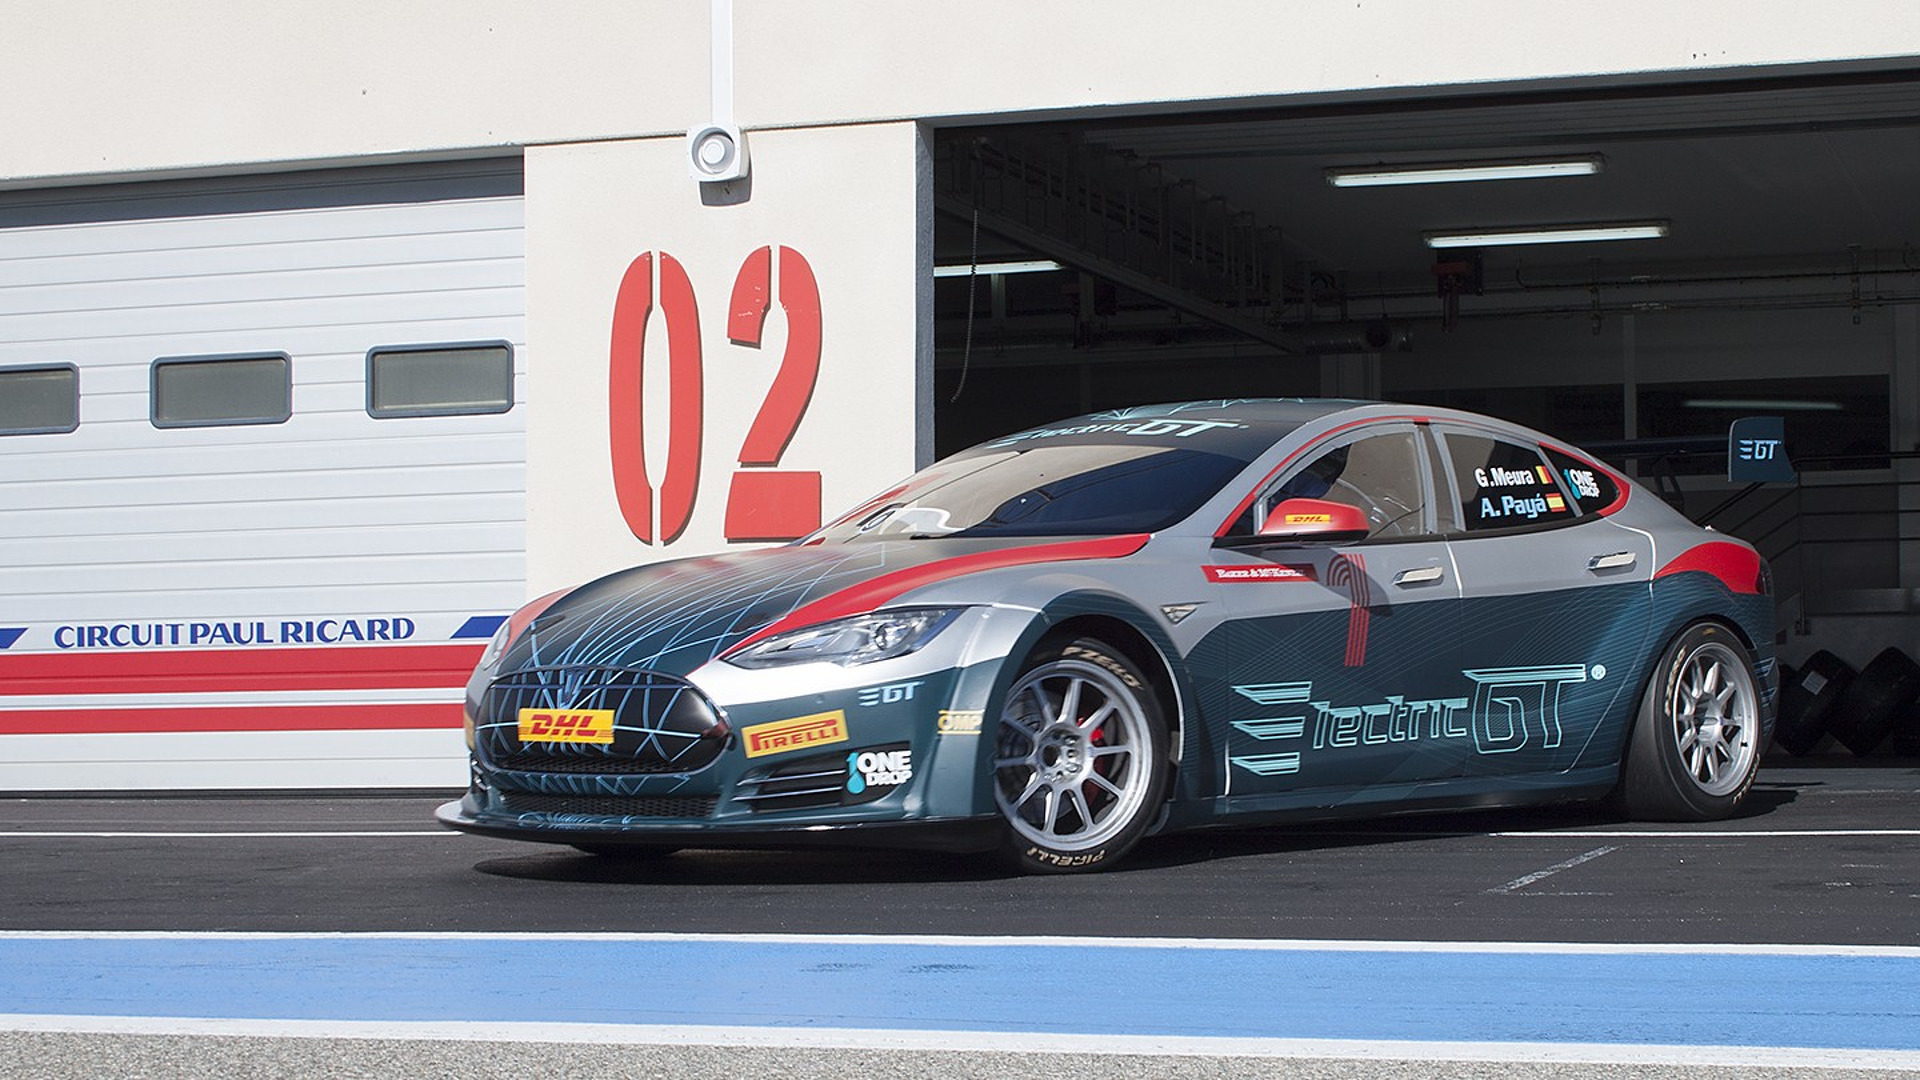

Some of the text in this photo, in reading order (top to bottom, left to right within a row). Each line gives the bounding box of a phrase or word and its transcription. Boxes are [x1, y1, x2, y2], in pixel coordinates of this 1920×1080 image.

[609, 244, 823, 545] 02
[1569, 468, 1595, 485] ONE
[1480, 493, 1548, 519] A. Payá
[53, 617, 416, 649] CIRCUIT PAUL RICARD
[531, 714, 603, 737] DHL
[751, 718, 842, 753] PIRELLI
[857, 751, 912, 773] ONE
[866, 768, 912, 787] DROP
